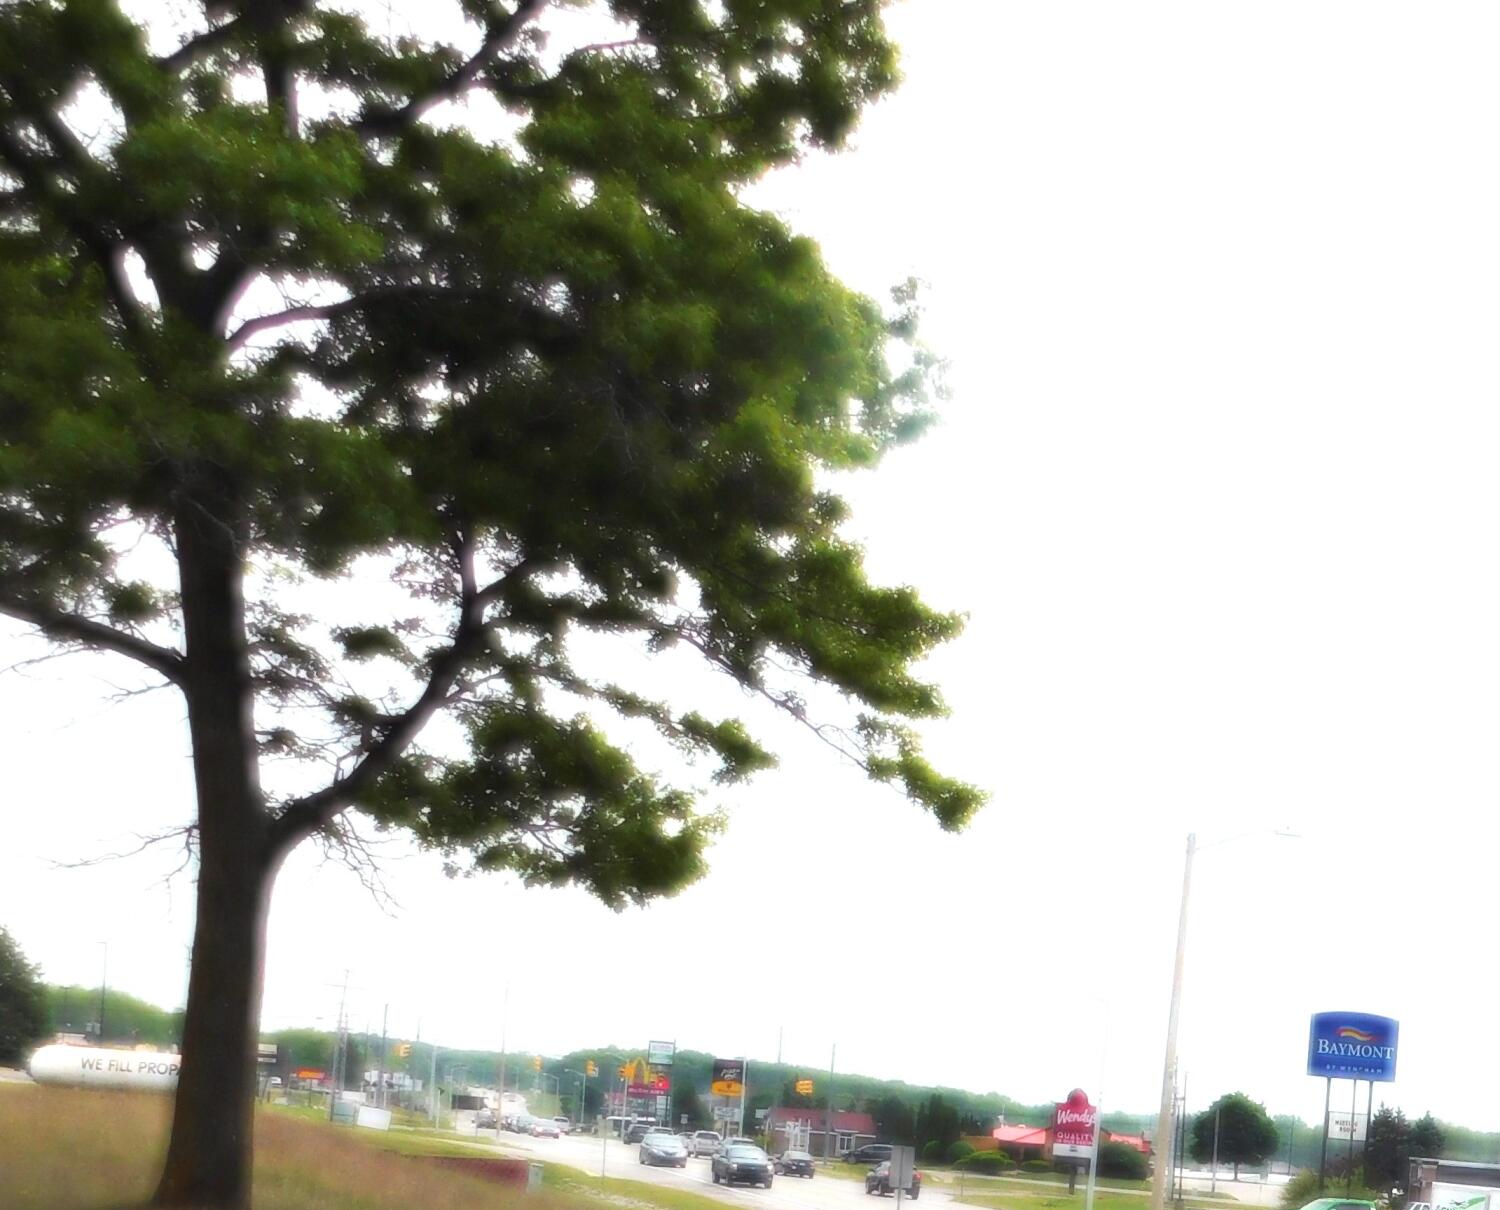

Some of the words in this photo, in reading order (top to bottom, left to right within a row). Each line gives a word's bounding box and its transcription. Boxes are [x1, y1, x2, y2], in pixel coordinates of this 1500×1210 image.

[1318, 1039, 1394, 1059] BAYMONT
[81, 1058, 103, 1071] WE
[108, 1060, 132, 1073] FILL
